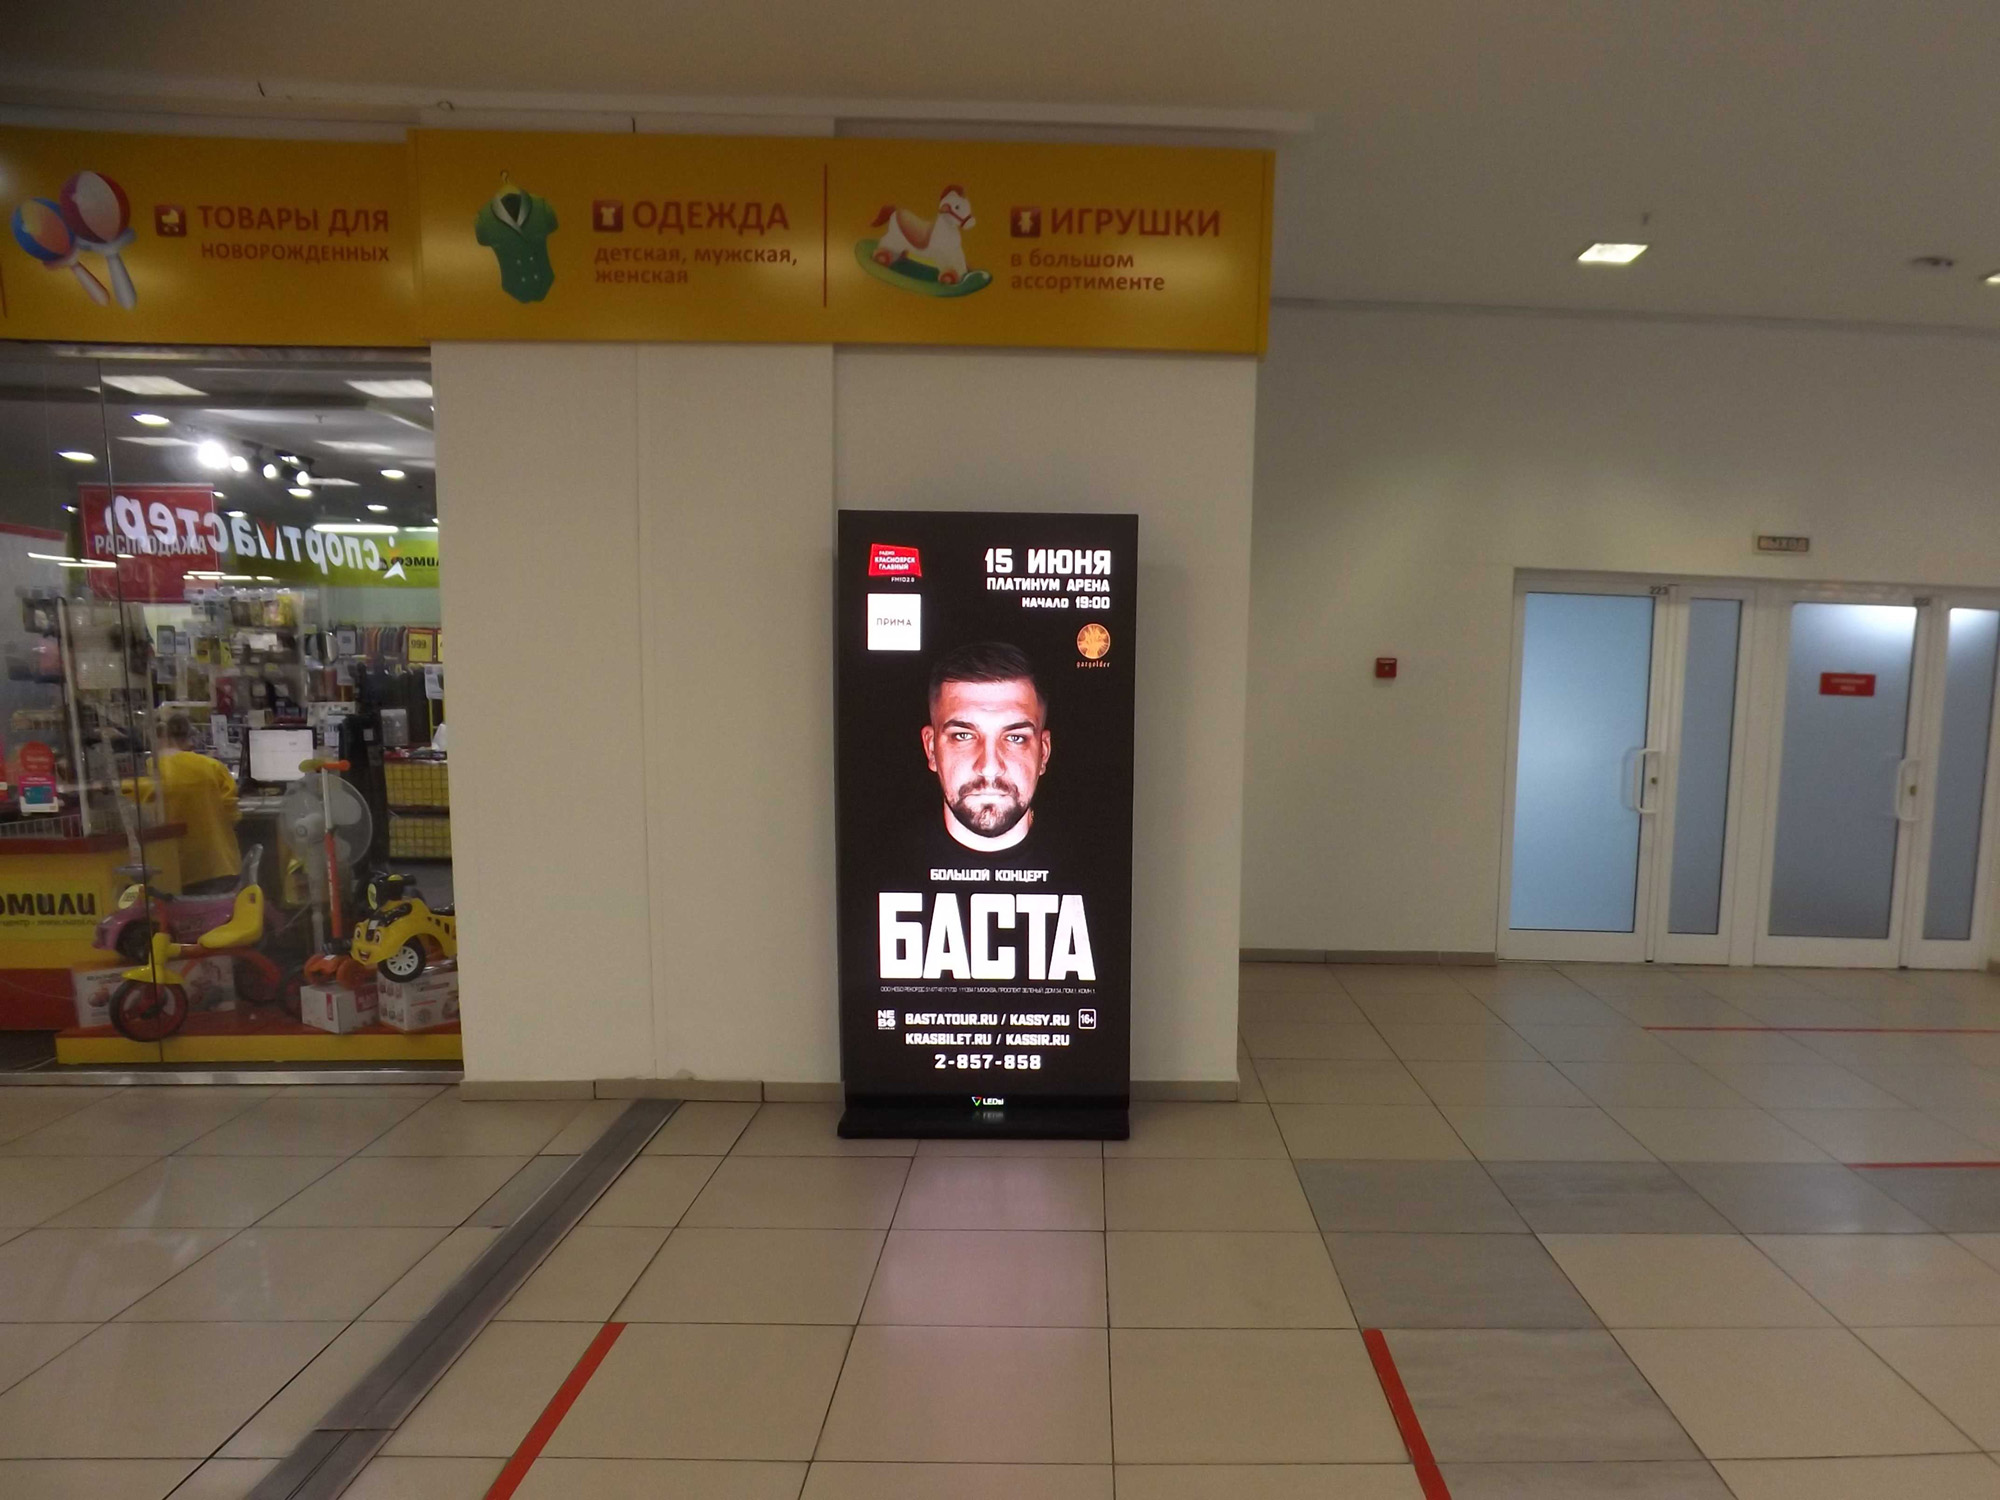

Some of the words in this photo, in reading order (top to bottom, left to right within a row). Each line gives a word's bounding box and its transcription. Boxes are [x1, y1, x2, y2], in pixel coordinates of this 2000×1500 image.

[198, 205, 319, 231] ТОВАРЫ
[328, 209, 389, 236] ДЛЯ
[633, 201, 789, 235] ОДЕЖДА
[1051, 208, 1220, 237] ИГРУШКИ
[201, 243, 388, 262] НОВОРОЖДЕННЫХ
[594, 246, 686, 264] детская,
[694, 248, 798, 266] мужская,
[1010, 253, 1021, 267] в
[1029, 249, 1134, 268] большом
[594, 270, 688, 283] женская
[1010, 275, 1165, 293] ассортименте
[95, 534, 208, 557] РАСПОДАЖА
[875, 556, 915, 564] КРАСНОЯРСК
[878, 563, 909, 571] ГЛАВНЫЙ
[985, 548, 1013, 574] 15
[1027, 548, 1112, 575] ИЮНЯ
[987, 577, 1060, 592] ПЛАТИНУМ
[1066, 578, 1110, 593] АРЕНА
[1022, 596, 1069, 609] НАЧАЛО
[1075, 596, 1110, 610] 19:00
[876, 617, 912, 626] ПРИМА
[930, 868, 990, 882] БОЛЬШОЙ
[994, 869, 1049, 883] КОНЦЕРТ
[878, 892, 1096, 981] БАСТА
[877, 1010, 896, 1019] NE
[905, 1013, 998, 1027] BASTATOUR.RU
[1009, 1014, 1070, 1028] KASSY.RU
[1080, 1015, 1094, 1025] 16+
[878, 1019, 896, 1028] BO
[905, 1033, 992, 1046] KRASBILET.RU
[1005, 1034, 1070, 1047] KASSIR.RU
[934, 1054, 1042, 1071] 2-857-858
